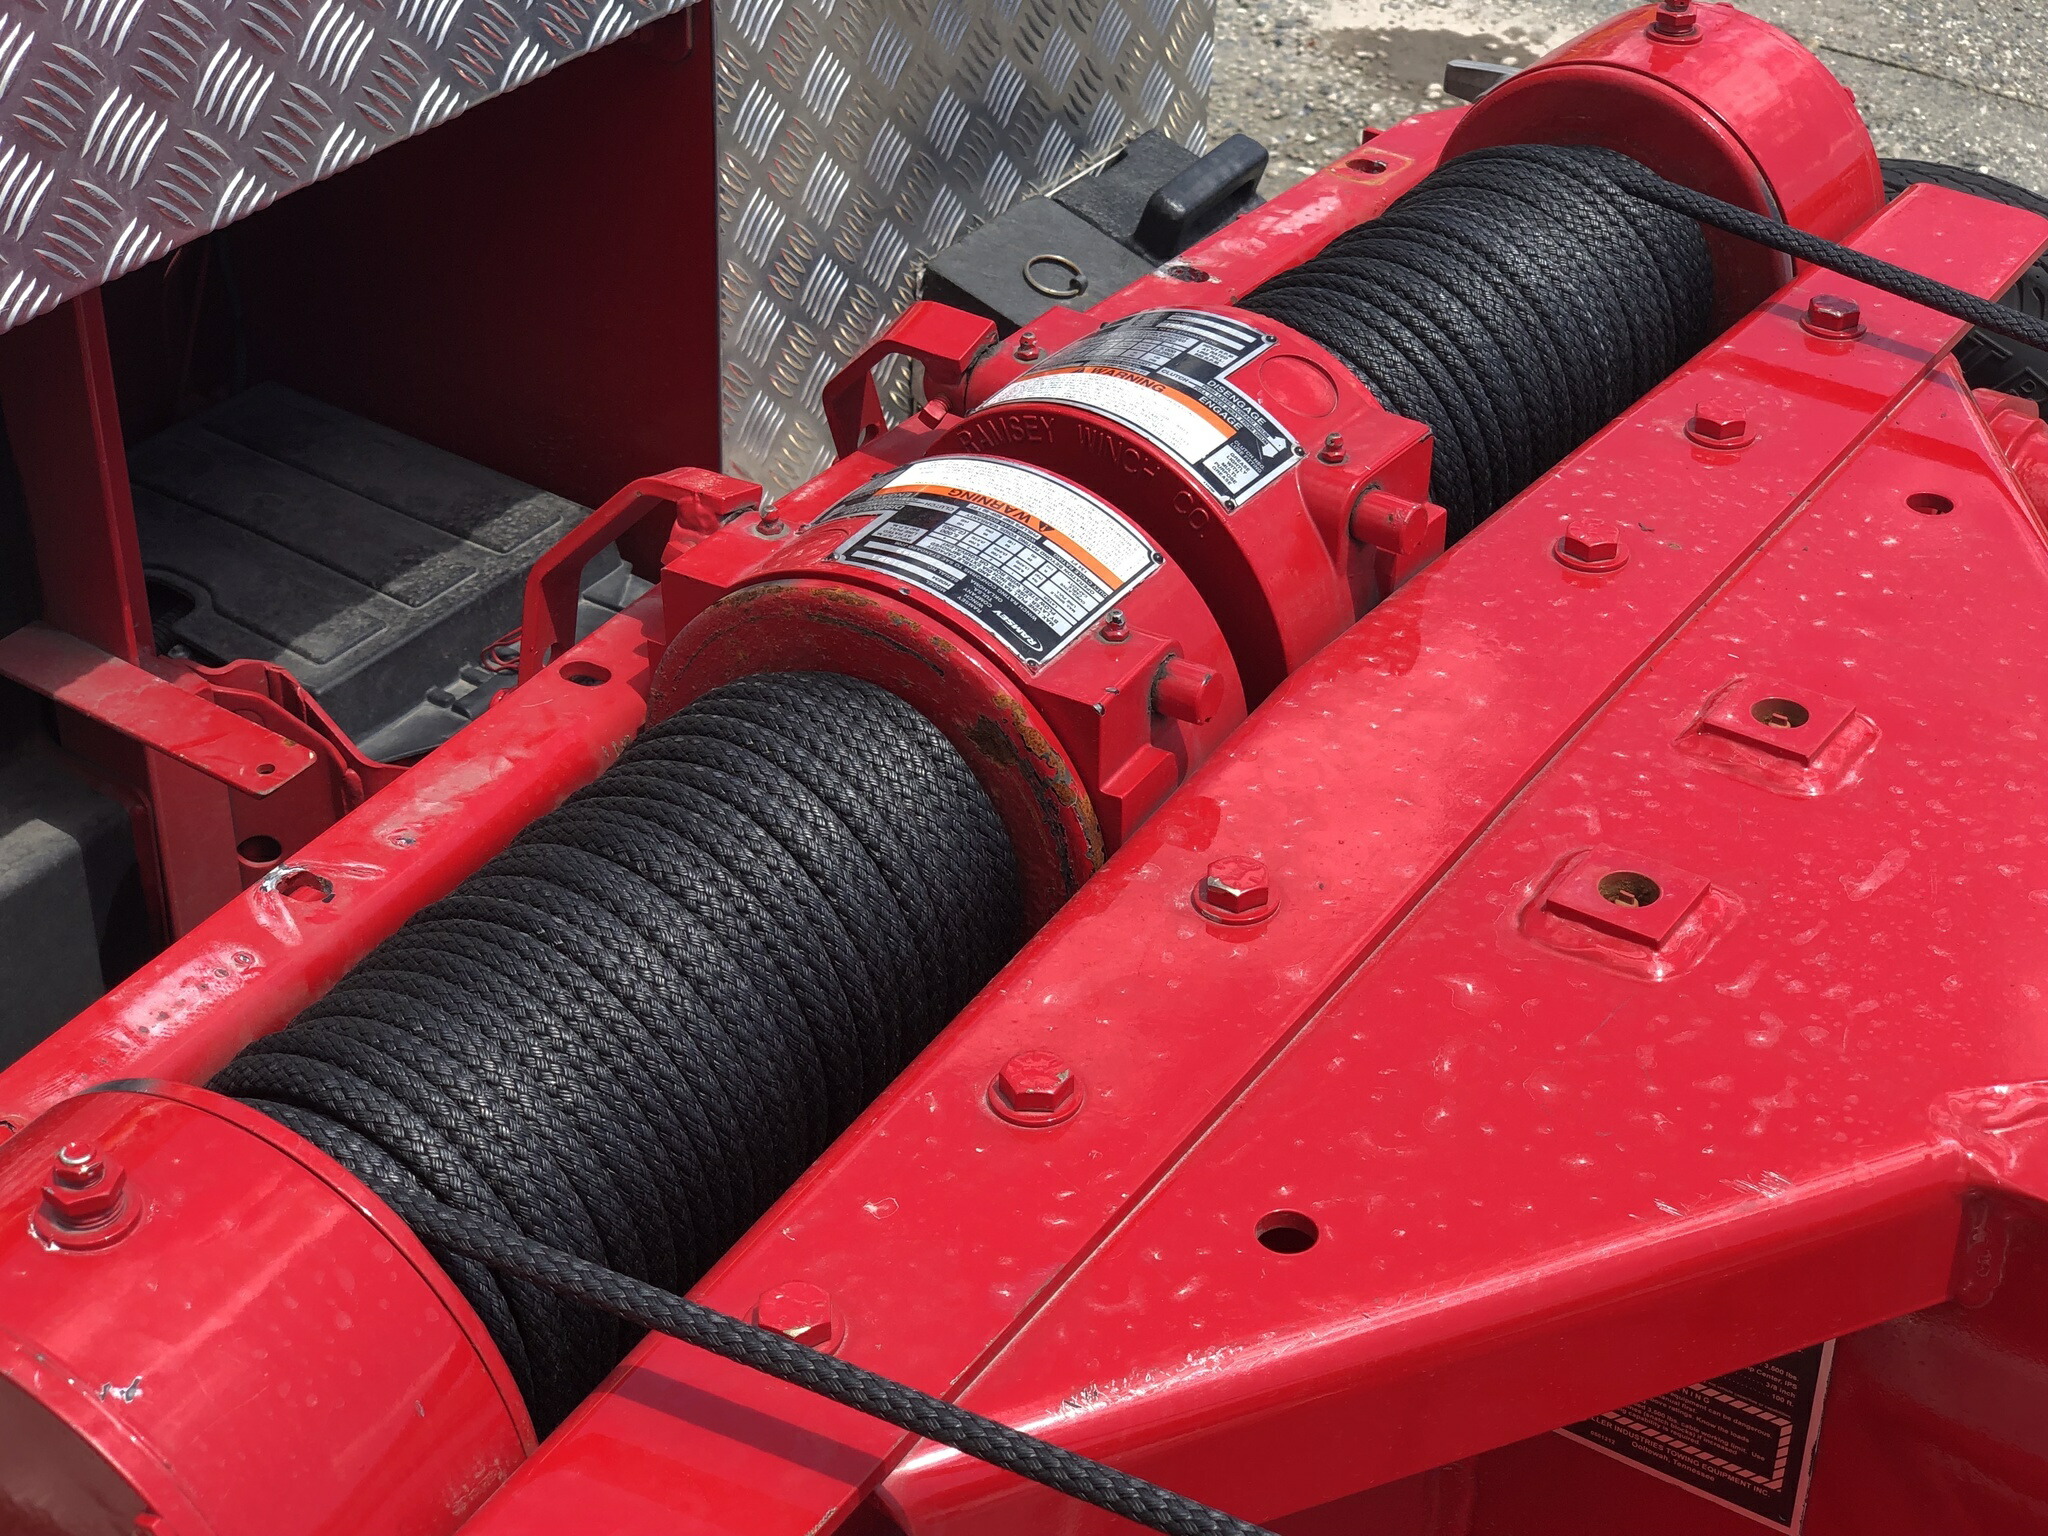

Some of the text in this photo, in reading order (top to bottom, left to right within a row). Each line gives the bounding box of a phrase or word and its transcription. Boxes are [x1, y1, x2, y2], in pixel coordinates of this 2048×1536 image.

[1091, 367, 1166, 393] WARNING
[1161, 369, 1189, 383] CLUTCH
[1207, 380, 1267, 426] DISENGAGE
[1199, 396, 1243, 430] ENGAGE
[1205, 393, 1224, 408] LEVER
[1223, 405, 1240, 419] AWAY
[1240, 418, 1256, 434] FROM
[1255, 432, 1269, 446] DRUM
[1214, 392, 1232, 406] LEVER
[1233, 405, 1255, 424] TOWARD
[1254, 422, 1270, 438] DRUM
[957, 415, 1055, 453] RAMSEY
[1077, 424, 1161, 477] WINCH
[1233, 440, 1257, 463] CLUTCH
[1226, 455, 1247, 475] LIGHTLY
[1230, 442, 1246, 457] LUBE
[1243, 455, 1263, 473] FITTING
[1230, 452, 1250, 472] GREASE
[1211, 465, 1232, 486] GREASE
[1213, 461, 1237, 485] PURPOSE
[1226, 461, 1240, 474] WITH
[923, 501, 955, 511] CLUTCH
[948, 488, 1032, 523] WARNING
[964, 513, 999, 528] WARRANTY
[999, 520, 1017, 532] GEAR
[939, 528, 960, 537] 5,000
[998, 526, 1017, 538] VOIDS
[1015, 522, 1039, 538] PHILLIPS
[1016, 530, 1036, 543] WORM
[907, 544, 941, 559] STANDARD
[924, 544, 957, 559] CAPACITY
[928, 541, 962, 556] IMPROVED
[940, 542, 981, 560] EQUIVALENT
[1017, 537, 1040, 552] RATING
[957, 556, 977, 569] CABLE
[960, 554, 981, 568] EXTRA
[1039, 550, 1063, 569] BEYOND
[1052, 552, 1074, 570] RATING
[935, 570, 960, 582] SERIAL
[962, 567, 997, 589] CONFORMS
[976, 567, 991, 577] AND
[988, 565, 1005, 576] ROPE
[992, 571, 1007, 583] INCH
[1073, 569, 1093, 585] CYCLE
[922, 580, 947, 591] MODEL
[990, 576, 1012, 593] RATING
[1005, 575, 1021, 587] WIRE
[1061, 568, 1096, 594] OPERATION
[970, 579, 1003, 603] OKLAHOMA
[995, 587, 1019, 605] RATING
[1012, 591, 1028, 604] PULL
[1015, 588, 1028, 598] USE
[1020, 586, 1040, 602] STEEL
[1055, 590, 1067, 600] PULL
[1092, 582, 1108, 597] DUTY
[956, 596, 982, 614] RAMSEY
[963, 588, 993, 608] COMPANY
[963, 593, 984, 609] WINCH
[1042, 596, 1058, 608] LAYER
[1066, 599, 1077, 608] LINE
[1016, 604, 1038, 621] WINCH
[1026, 602, 1041, 614] LINE
[1030, 600, 1051, 616] LAYER
[1038, 601, 1057, 615] PLOW
[1049, 615, 1059, 623] BY
[991, 610, 1037, 646] RAMSEY
[1756, 1368, 1783, 1385] Center,
[1784, 1380, 1798, 1390] IPS
[1765, 1381, 1778, 1391] 3/8
[1657, 1393, 1680, 1406] anual
[1681, 1402, 1698, 1413] first.
[1678, 1386, 1710, 1404] NING
[1772, 1393, 1784, 1402] 100
[1670, 1392, 1772, 1439] equipment can be dangerous.
[1627, 1410, 1661, 1428] capability
[1669, 1429, 1700, 1446] required.
[1668, 1405, 1694, 1419] ratings.
[1696, 1416, 1716, 1429] Know
[1717, 1425, 1728, 1434] the
[1730, 1431, 1749, 1443] loads
[1643, 1411, 1669, 1426] (snatch
[1669, 1423, 1695, 1437] blocks)
[1703, 1437, 1737, 1455] increased
[1680, 1421, 1700, 1433] cable
[1700, 1430, 1729, 1446] working
[1730, 1442, 1747, 1454] limit.
[1750, 1451, 1765, 1461] Use
[1613, 1424, 1663, 1451] INDUSTRIES
[1665, 1447, 1699, 1466] TOWING
[1701, 1462, 1751, 1489] EQUIPMENT
[1753, 1485, 1771, 1497] INC.
[1631, 1440, 1715, 1481] Ooltowah, Tennessee
